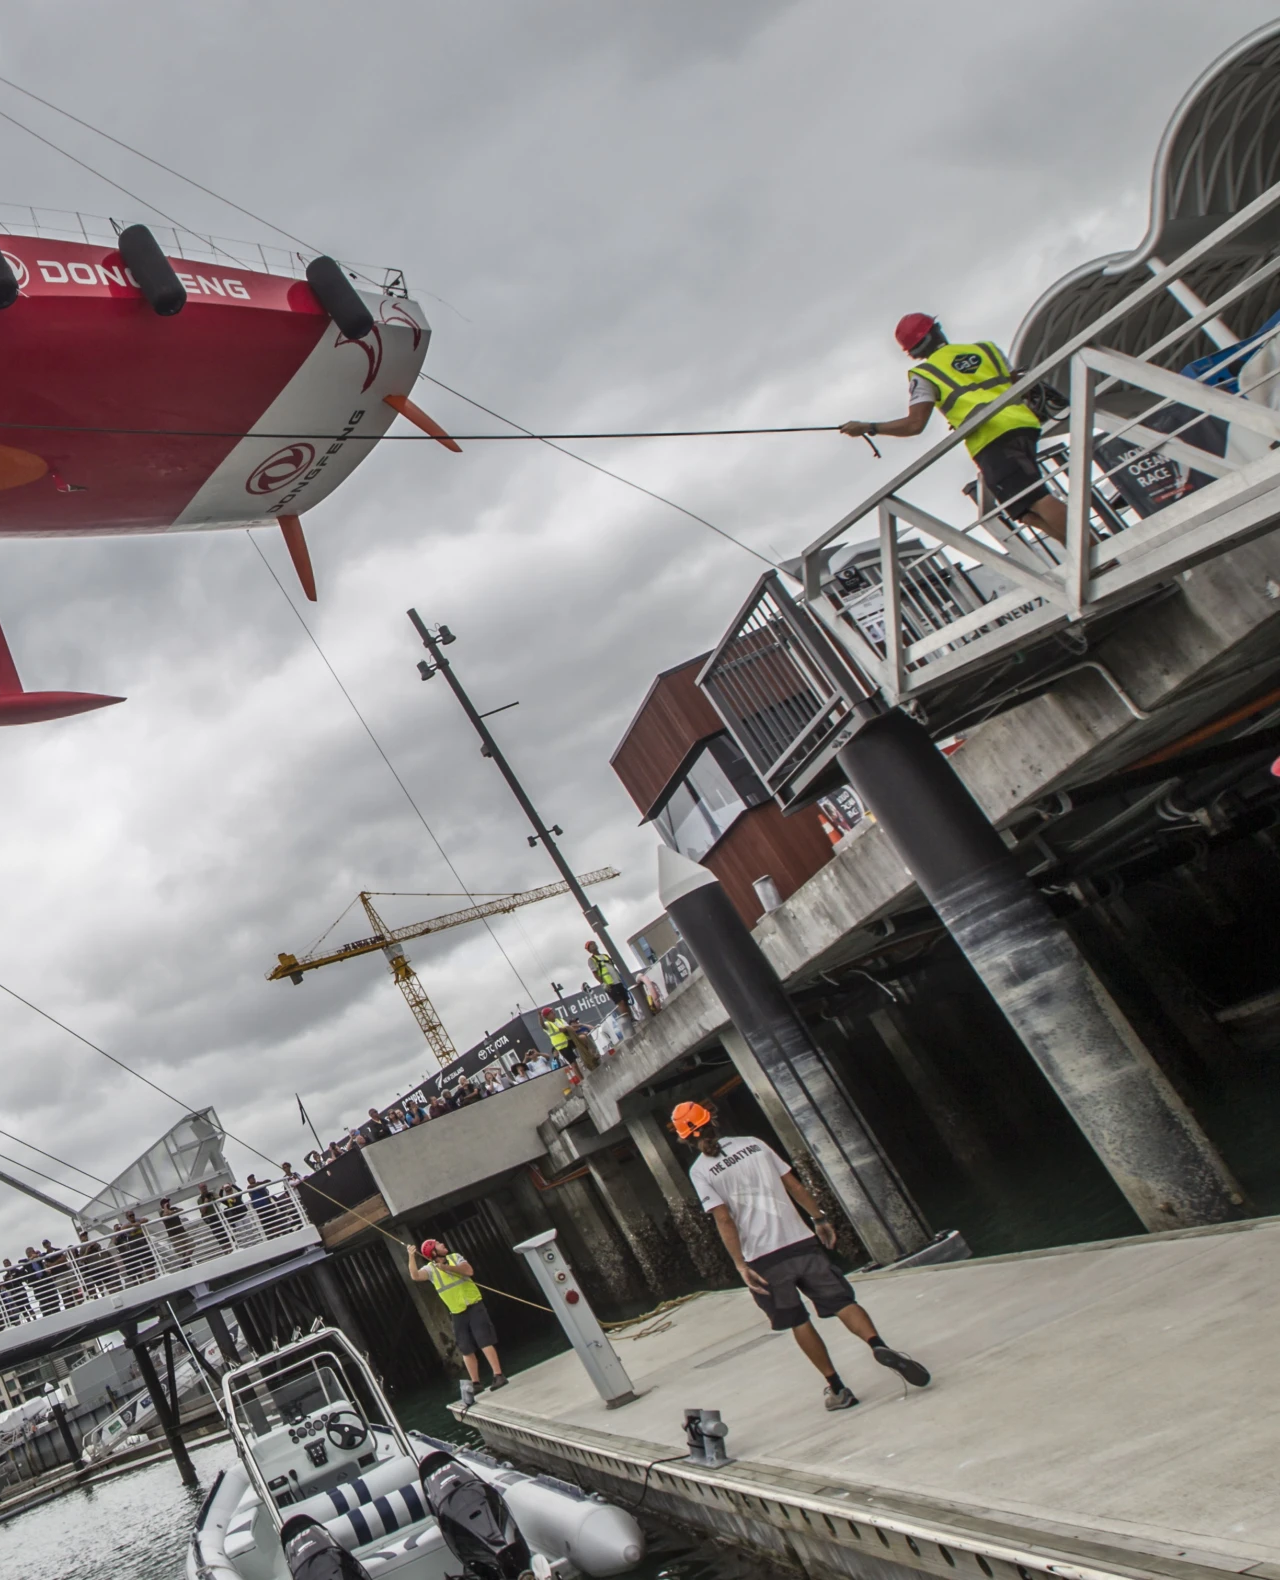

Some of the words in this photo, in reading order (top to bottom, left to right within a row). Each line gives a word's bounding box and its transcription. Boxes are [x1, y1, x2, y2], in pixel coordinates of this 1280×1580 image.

[36, 260, 251, 300] DONENG
[265, 410, 366, 514] DONGFENG
[1136, 467, 1172, 488] RACE
[709, 1163, 726, 1176] THE
